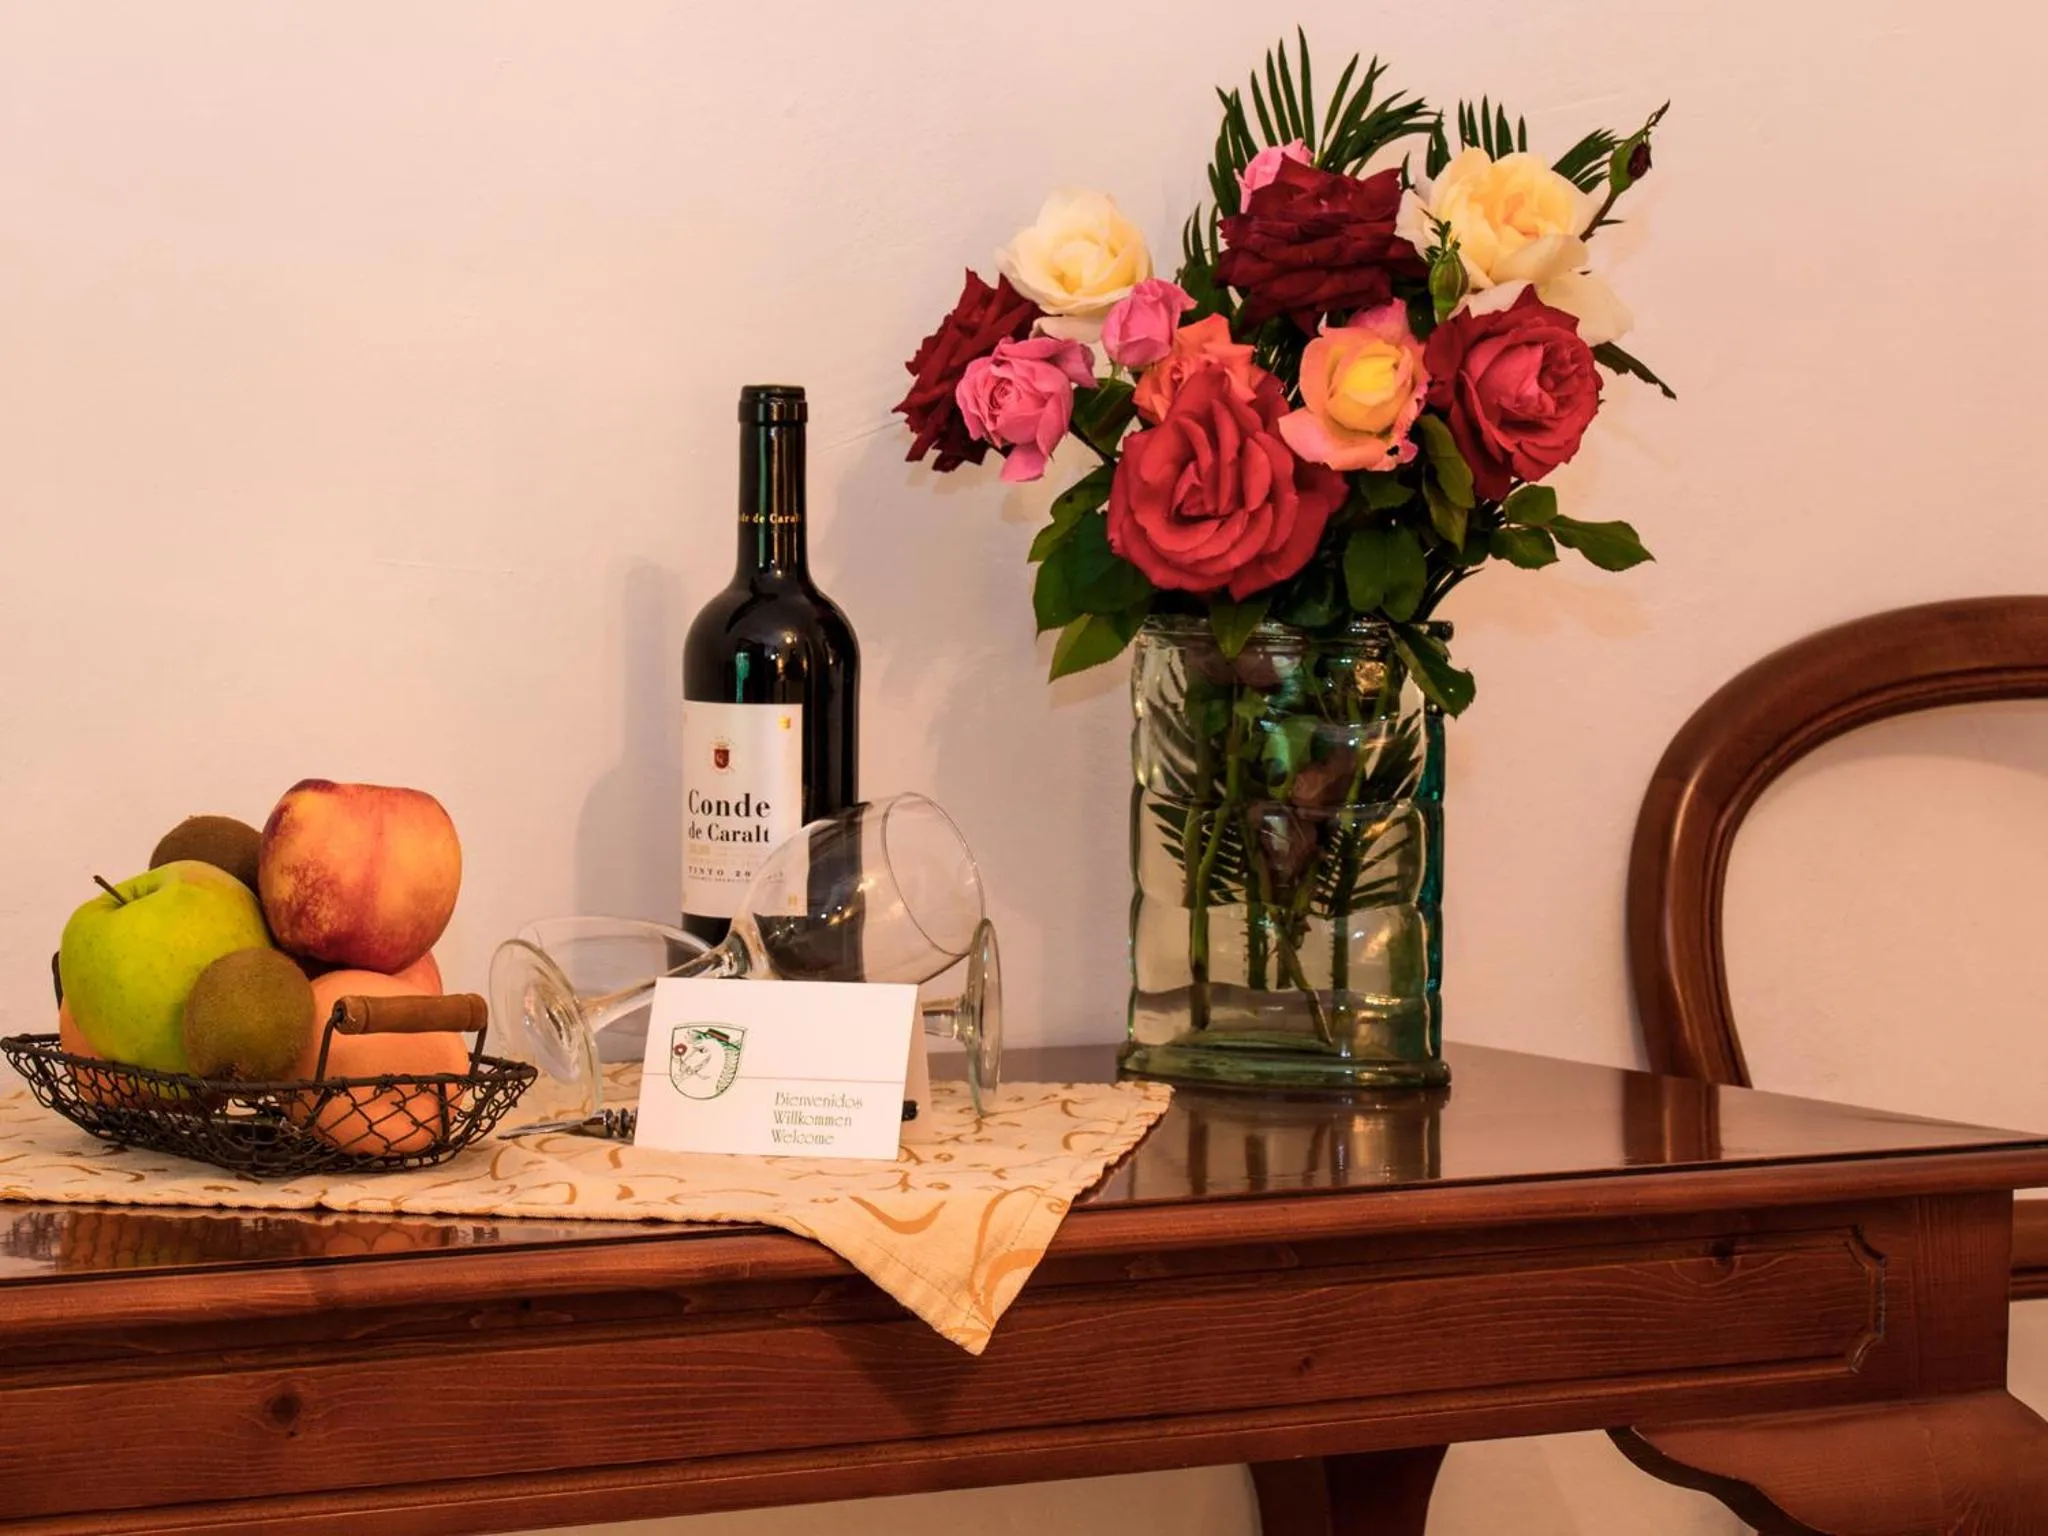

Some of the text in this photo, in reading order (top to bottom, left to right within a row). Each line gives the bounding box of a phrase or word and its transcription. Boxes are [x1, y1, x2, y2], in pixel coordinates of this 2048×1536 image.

[752, 512, 765, 524] de
[769, 512, 801, 524] Caral
[688, 788, 771, 818] Conde
[688, 820, 770, 843] de Caralt
[687, 865, 724, 876] TINTO
[774, 1091, 863, 1109] Bienvenidos
[773, 1110, 853, 1127] Willkommen
[771, 1128, 835, 1145] Welcome
